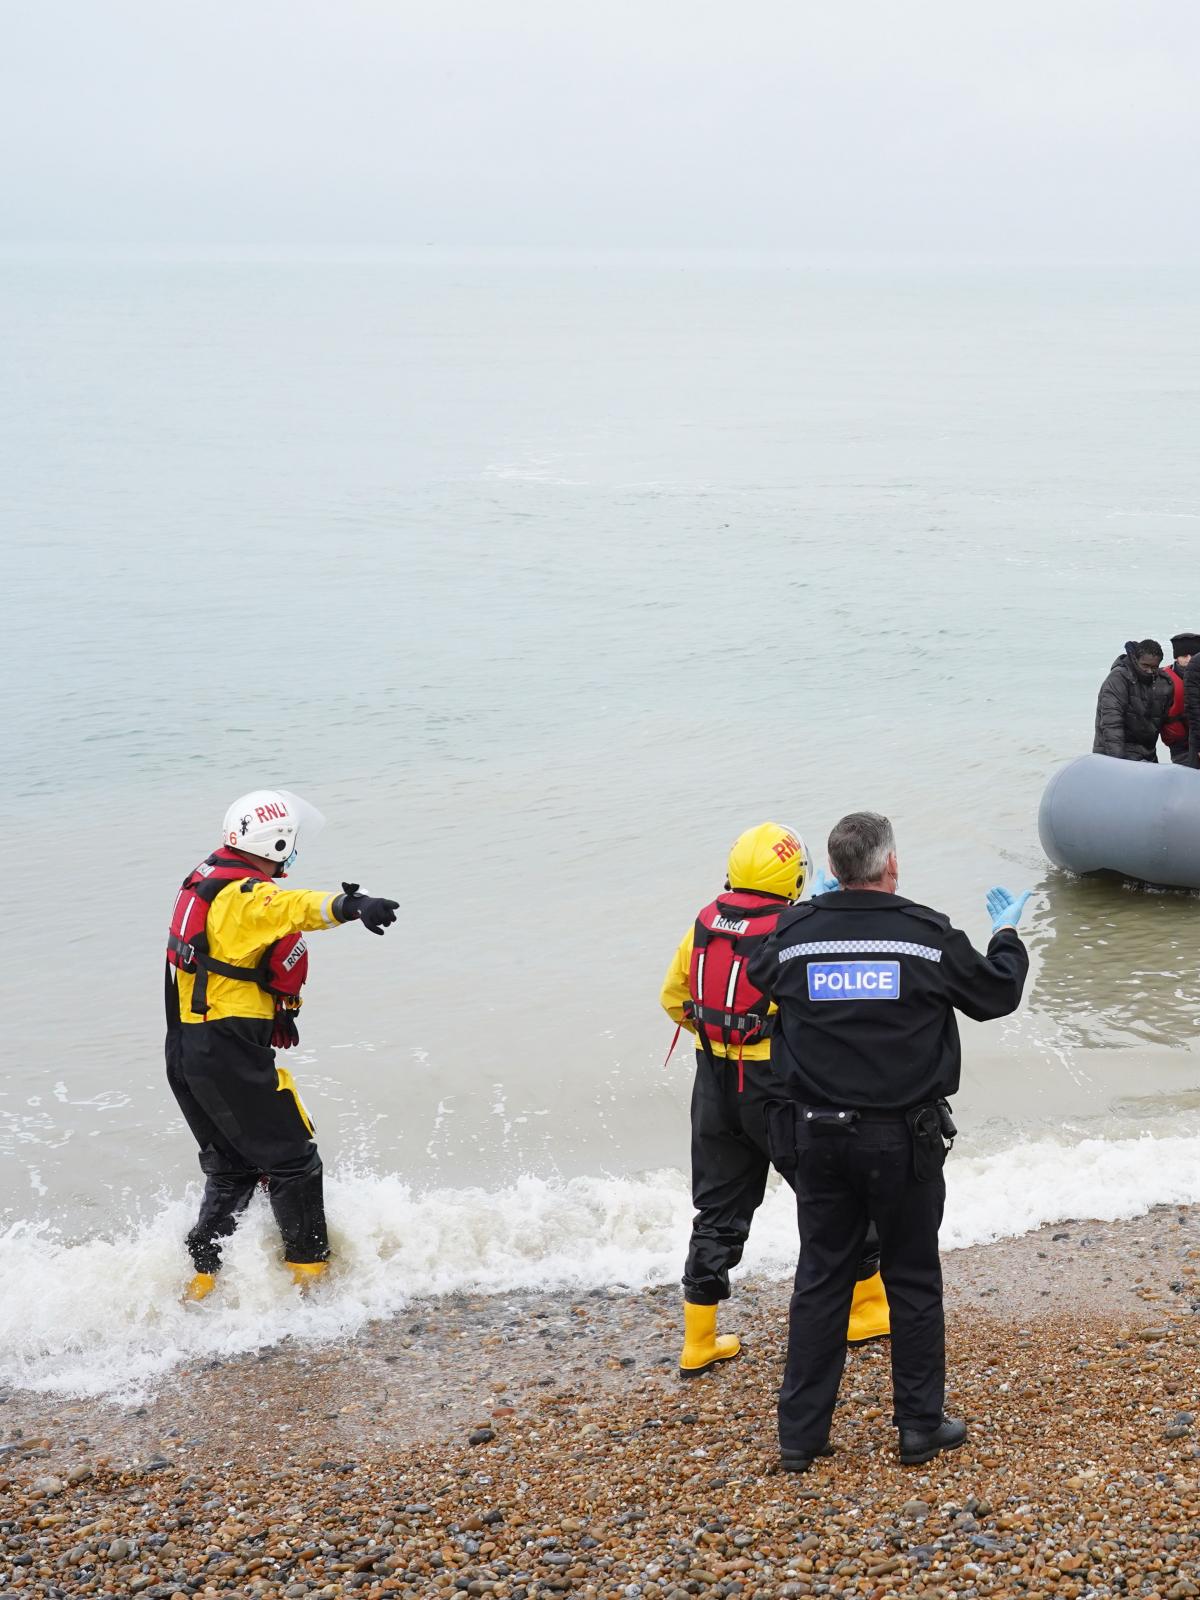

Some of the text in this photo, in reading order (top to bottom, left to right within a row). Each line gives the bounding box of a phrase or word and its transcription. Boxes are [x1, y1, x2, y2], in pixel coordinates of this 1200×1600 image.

[255, 802, 289, 823] RNLI
[772, 834, 801, 863] RNL
[287, 942, 306, 967] RNLI
[814, 971, 893, 991] POLICE
